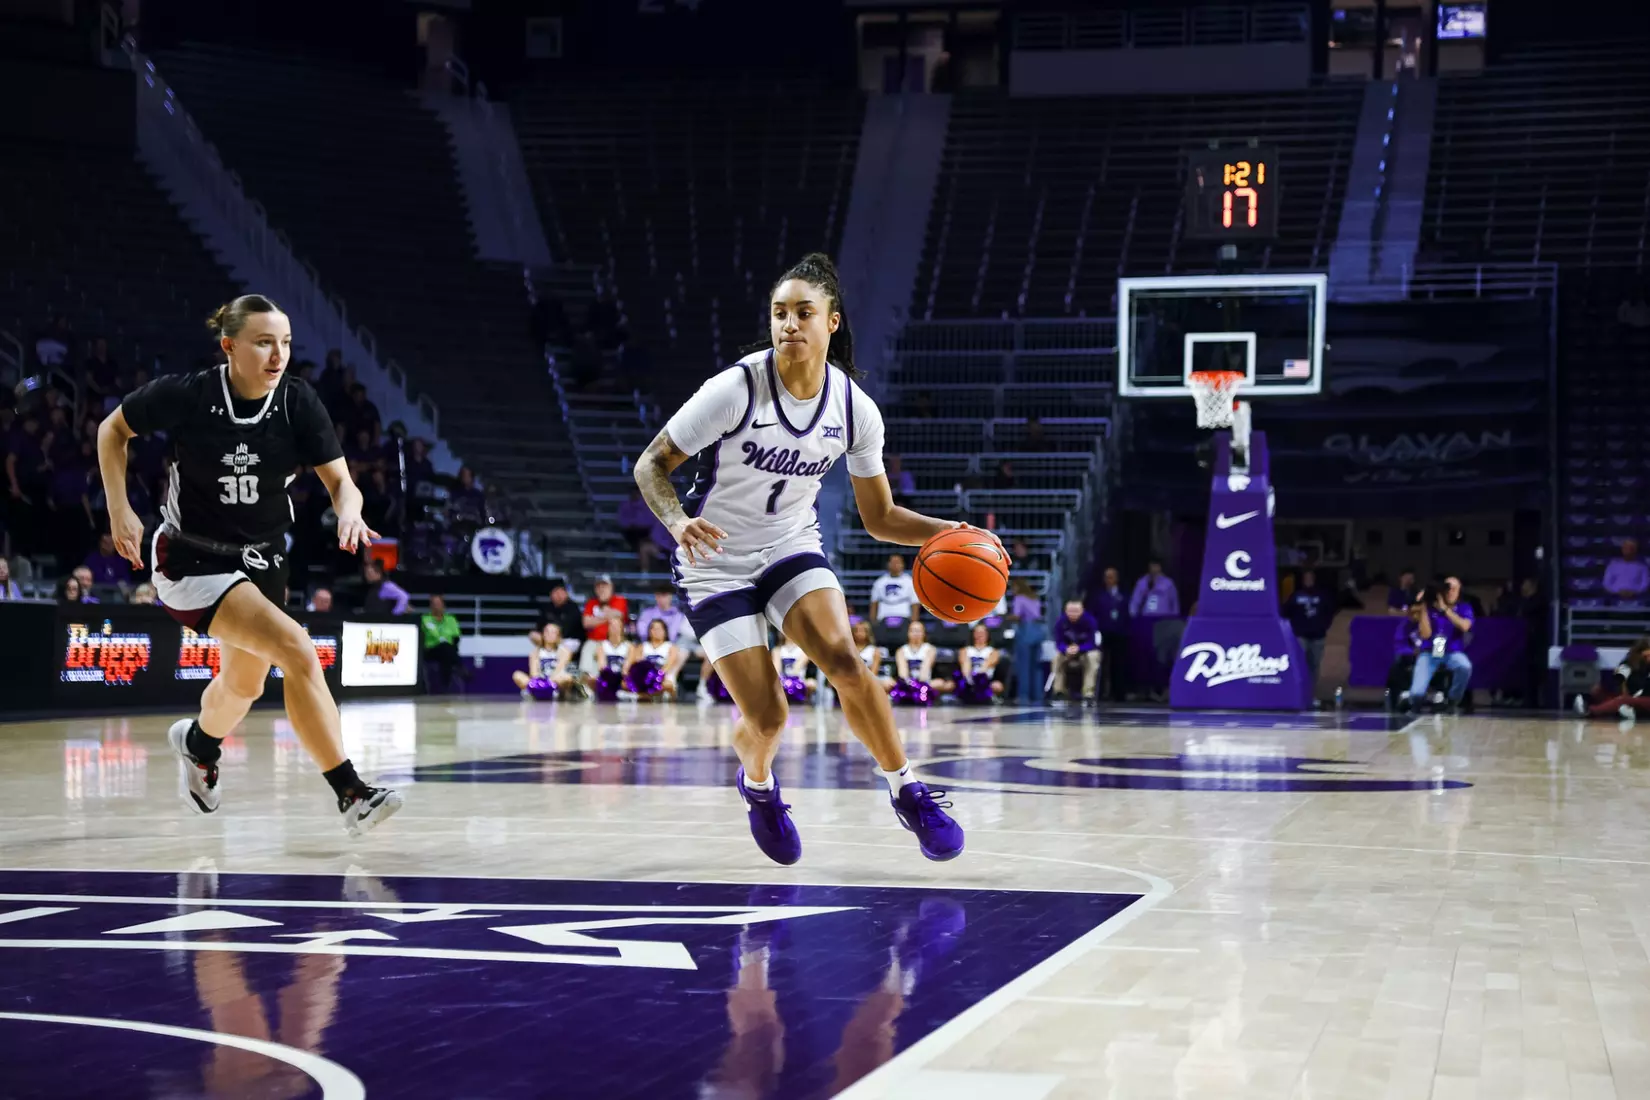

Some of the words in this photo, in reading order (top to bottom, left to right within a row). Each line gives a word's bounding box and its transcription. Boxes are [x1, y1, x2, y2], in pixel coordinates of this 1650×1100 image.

[1224, 161, 1265, 187] 1:21
[1223, 187, 1258, 229] 17
[217, 475, 260, 505] 30
[765, 479, 788, 515] 1
[1209, 577, 1266, 591] Channel
[1180, 641, 1289, 687] Dillons
